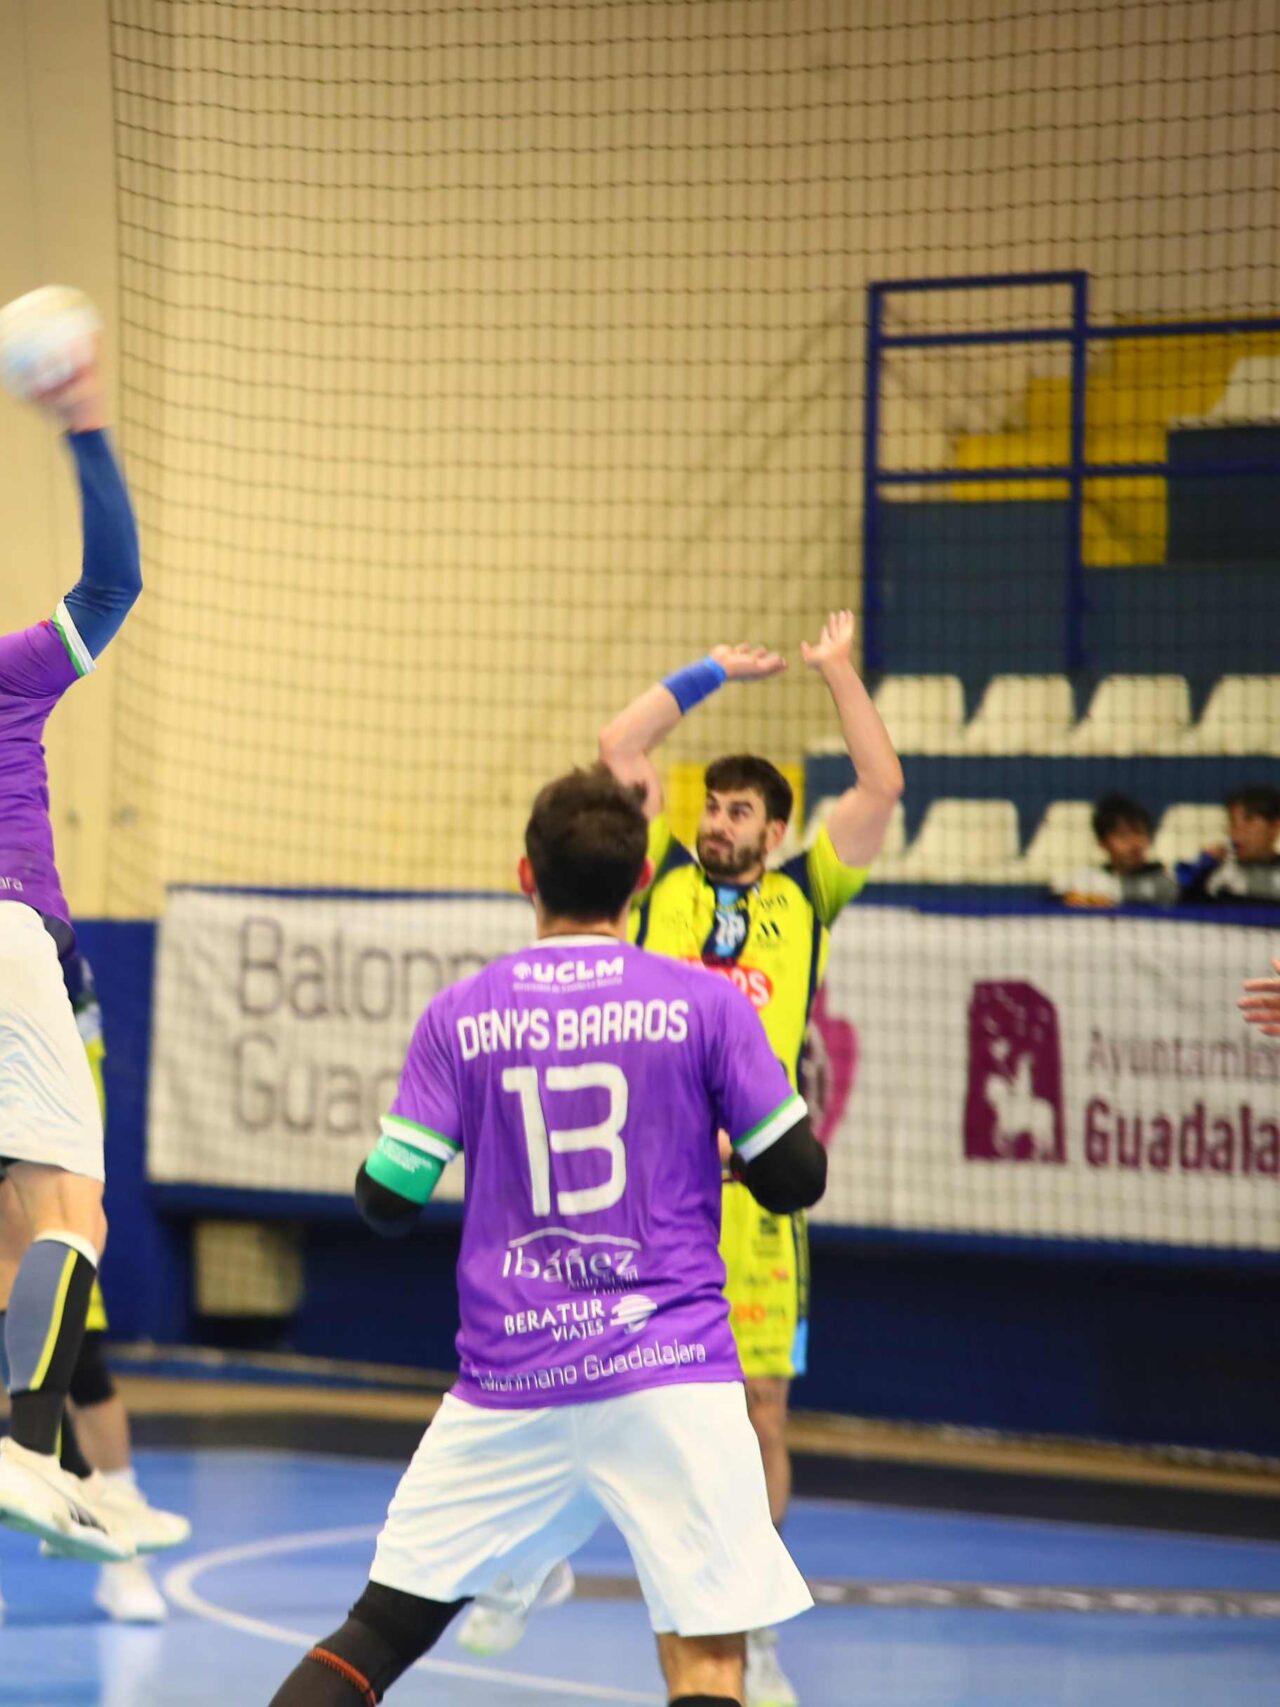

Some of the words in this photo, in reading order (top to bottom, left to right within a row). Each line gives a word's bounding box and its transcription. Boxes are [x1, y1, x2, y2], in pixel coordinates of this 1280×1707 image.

[532, 956, 625, 985] UCLM
[456, 1007, 551, 1062] DENYS
[556, 998, 690, 1051] BARROS
[501, 1062, 629, 1217] 13
[504, 1298, 606, 1336] BERATUR
[551, 1317, 605, 1343] VIAJES
[583, 1338, 706, 1382] Guadalajara
